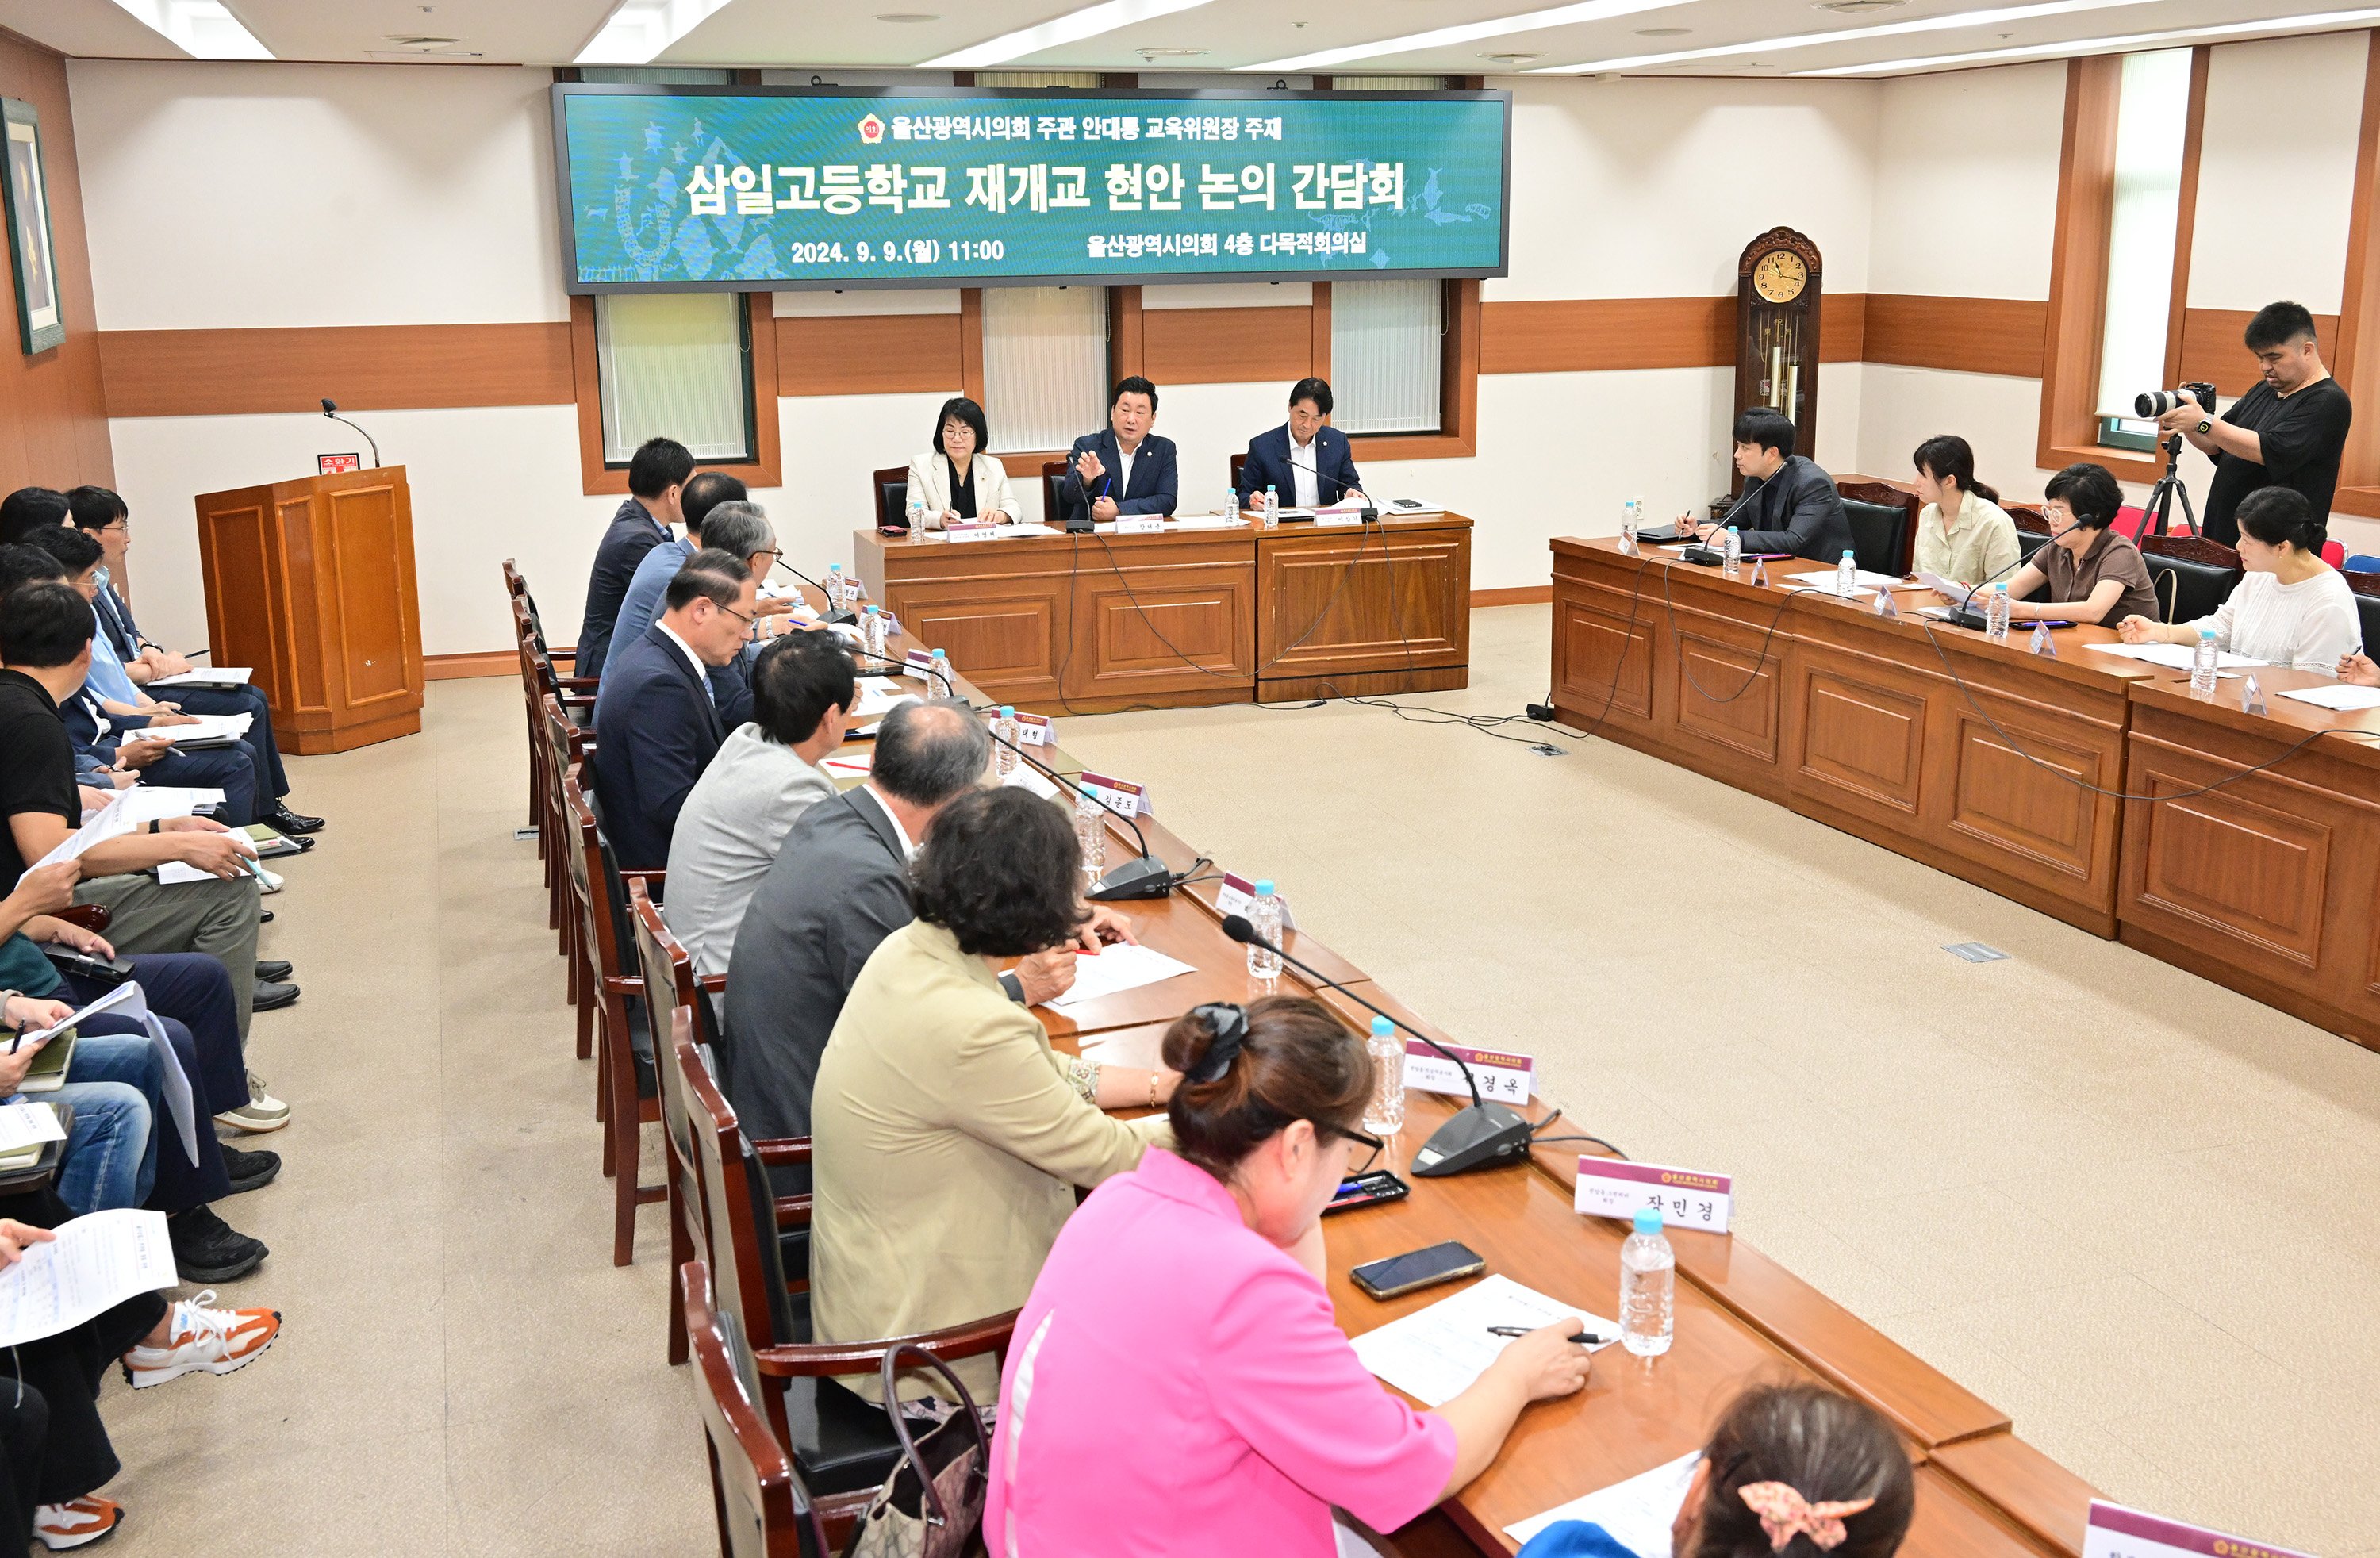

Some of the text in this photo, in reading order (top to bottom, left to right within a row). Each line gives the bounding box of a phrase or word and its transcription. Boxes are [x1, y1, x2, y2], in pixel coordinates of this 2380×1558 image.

[891, 116, 1031, 140] 울산광역시의회
[1036, 117, 1077, 140] 주관
[1146, 117, 1239, 140] 교육위원장
[1244, 117, 1283, 141] 주재
[685, 162, 1404, 216] 삼일고등학교 재개교 현안 논의 간담회
[792, 240, 1004, 263] 2024. 9. 9.(월) 11:00
[1088, 231, 1367, 258] 울산광역시의회 4층 다목적회의실
